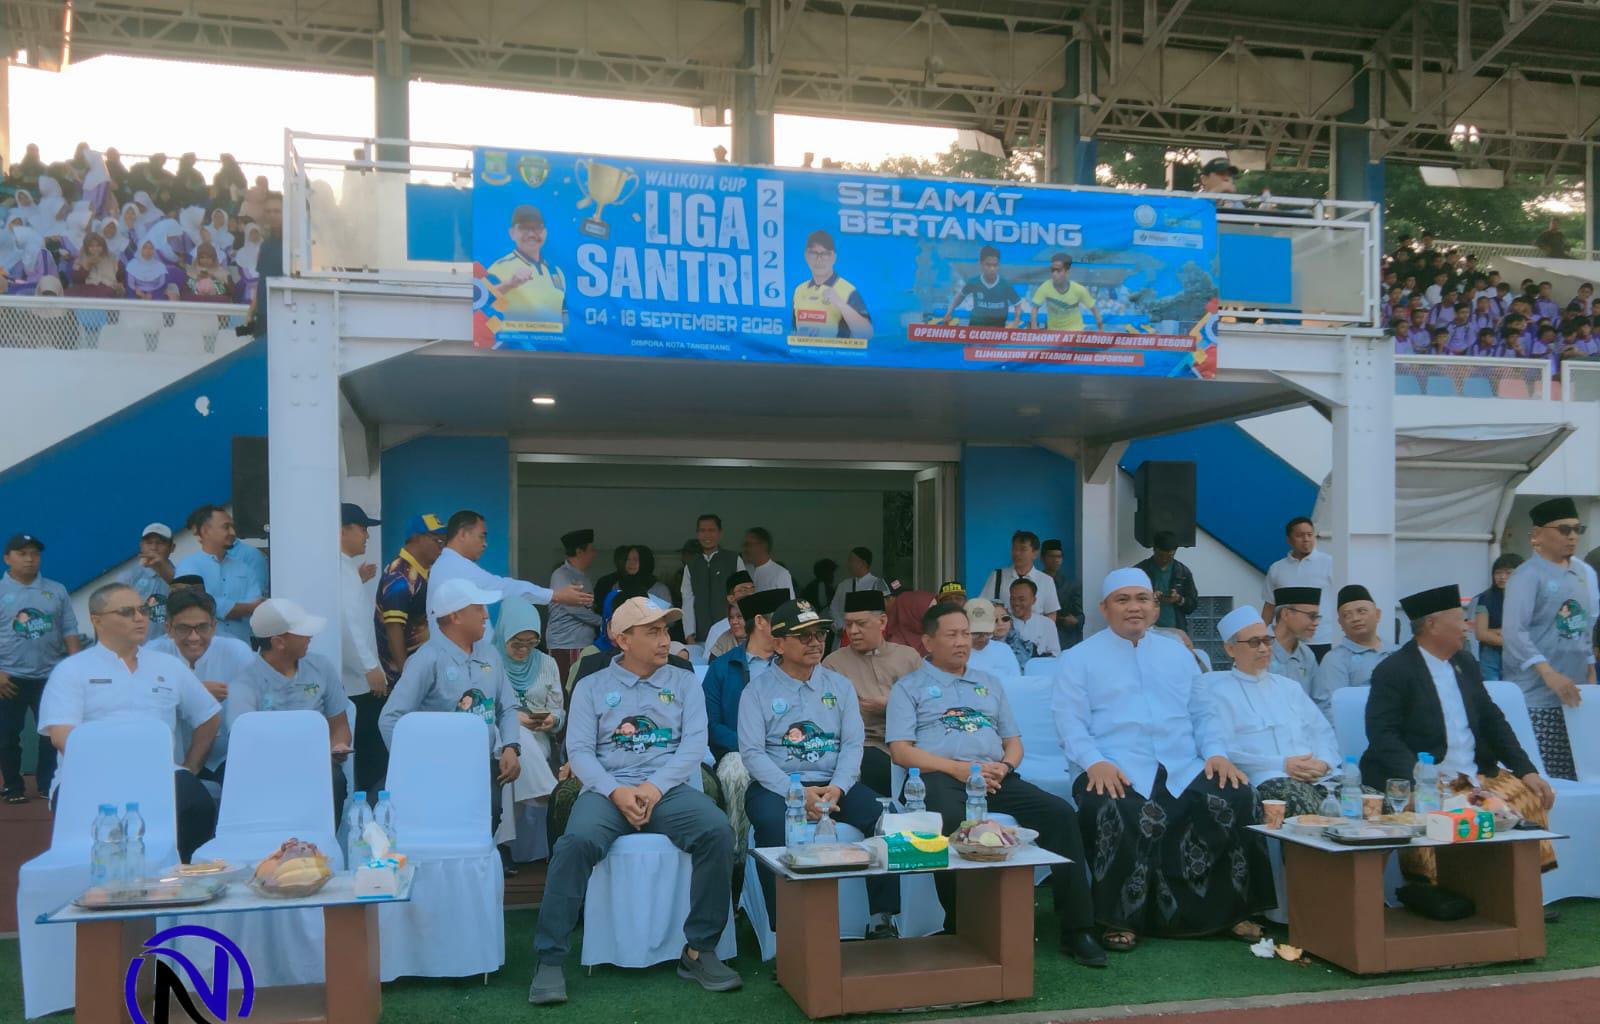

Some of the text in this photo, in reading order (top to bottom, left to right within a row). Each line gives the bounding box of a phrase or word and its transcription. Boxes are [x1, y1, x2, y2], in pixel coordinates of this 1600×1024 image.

[645, 169, 748, 192] WALIKOTA CUP
[838, 181, 1023, 216] SELAMAT
[645, 190, 751, 250] LIGA
[838, 208, 1083, 247] BERTANDING
[576, 243, 754, 306] SANTRI
[585, 307, 608, 326] 04
[621, 309, 636, 327] 18
[640, 311, 738, 332] SEPTEMBER
[741, 317, 784, 336] 2026
[913, 327, 956, 339] OPENING
[958, 329, 967, 339] &
[969, 330, 1009, 341] CLOSING
[1010, 331, 1061, 343] CEREMONY
[1062, 334, 1075, 343] AT
[1075, 334, 1113, 345] STADION
[631, 339, 664, 349] DISPORA
[666, 340, 685, 349] KOTA
